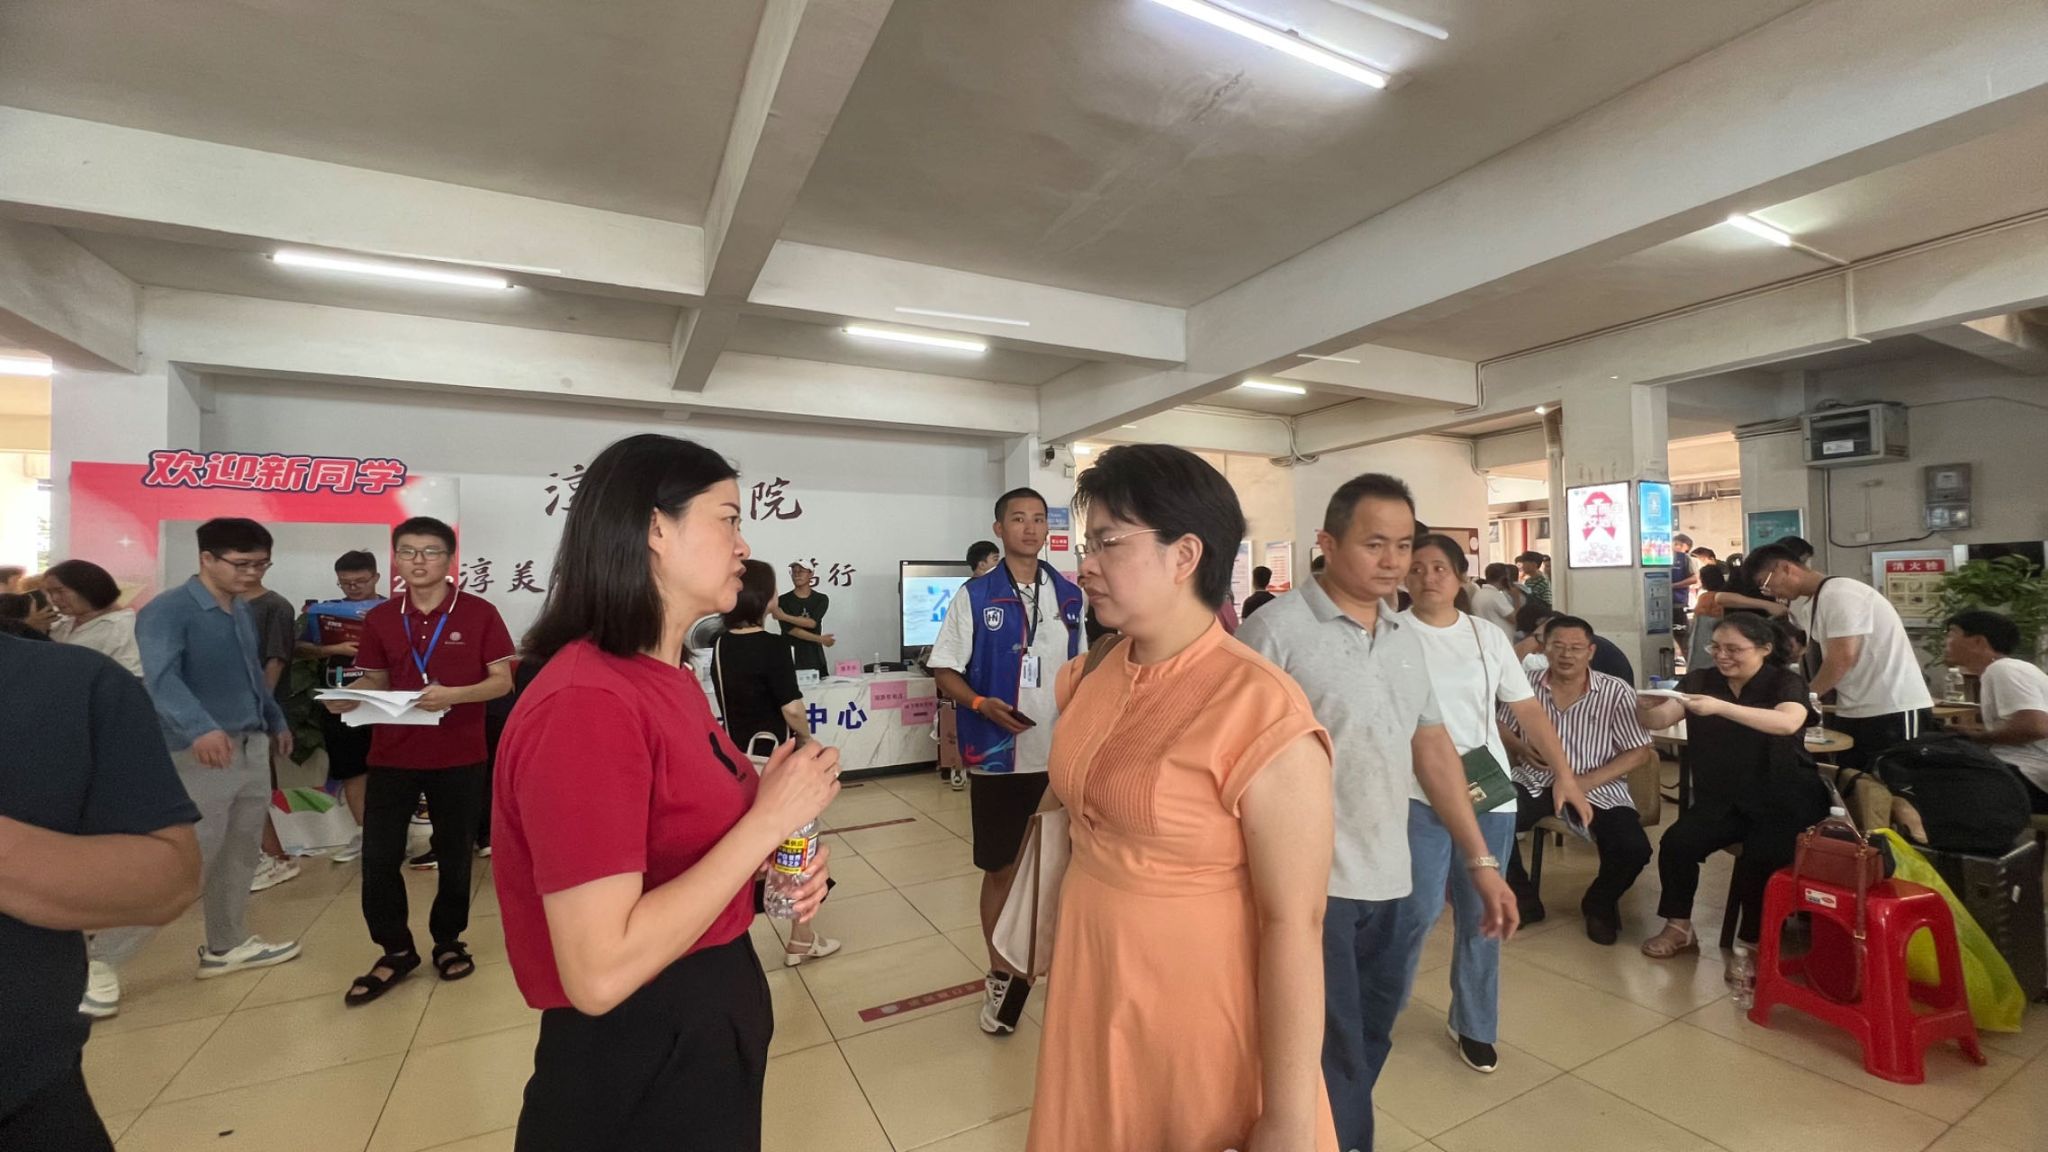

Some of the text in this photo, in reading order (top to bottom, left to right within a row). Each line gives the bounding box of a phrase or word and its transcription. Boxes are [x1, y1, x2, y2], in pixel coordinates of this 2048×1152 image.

[144, 450, 408, 494] 欢迎新同学
[749, 476, 803, 521] 院
[459, 557, 545, 594] 淳美
[806, 701, 867, 734] 中心
